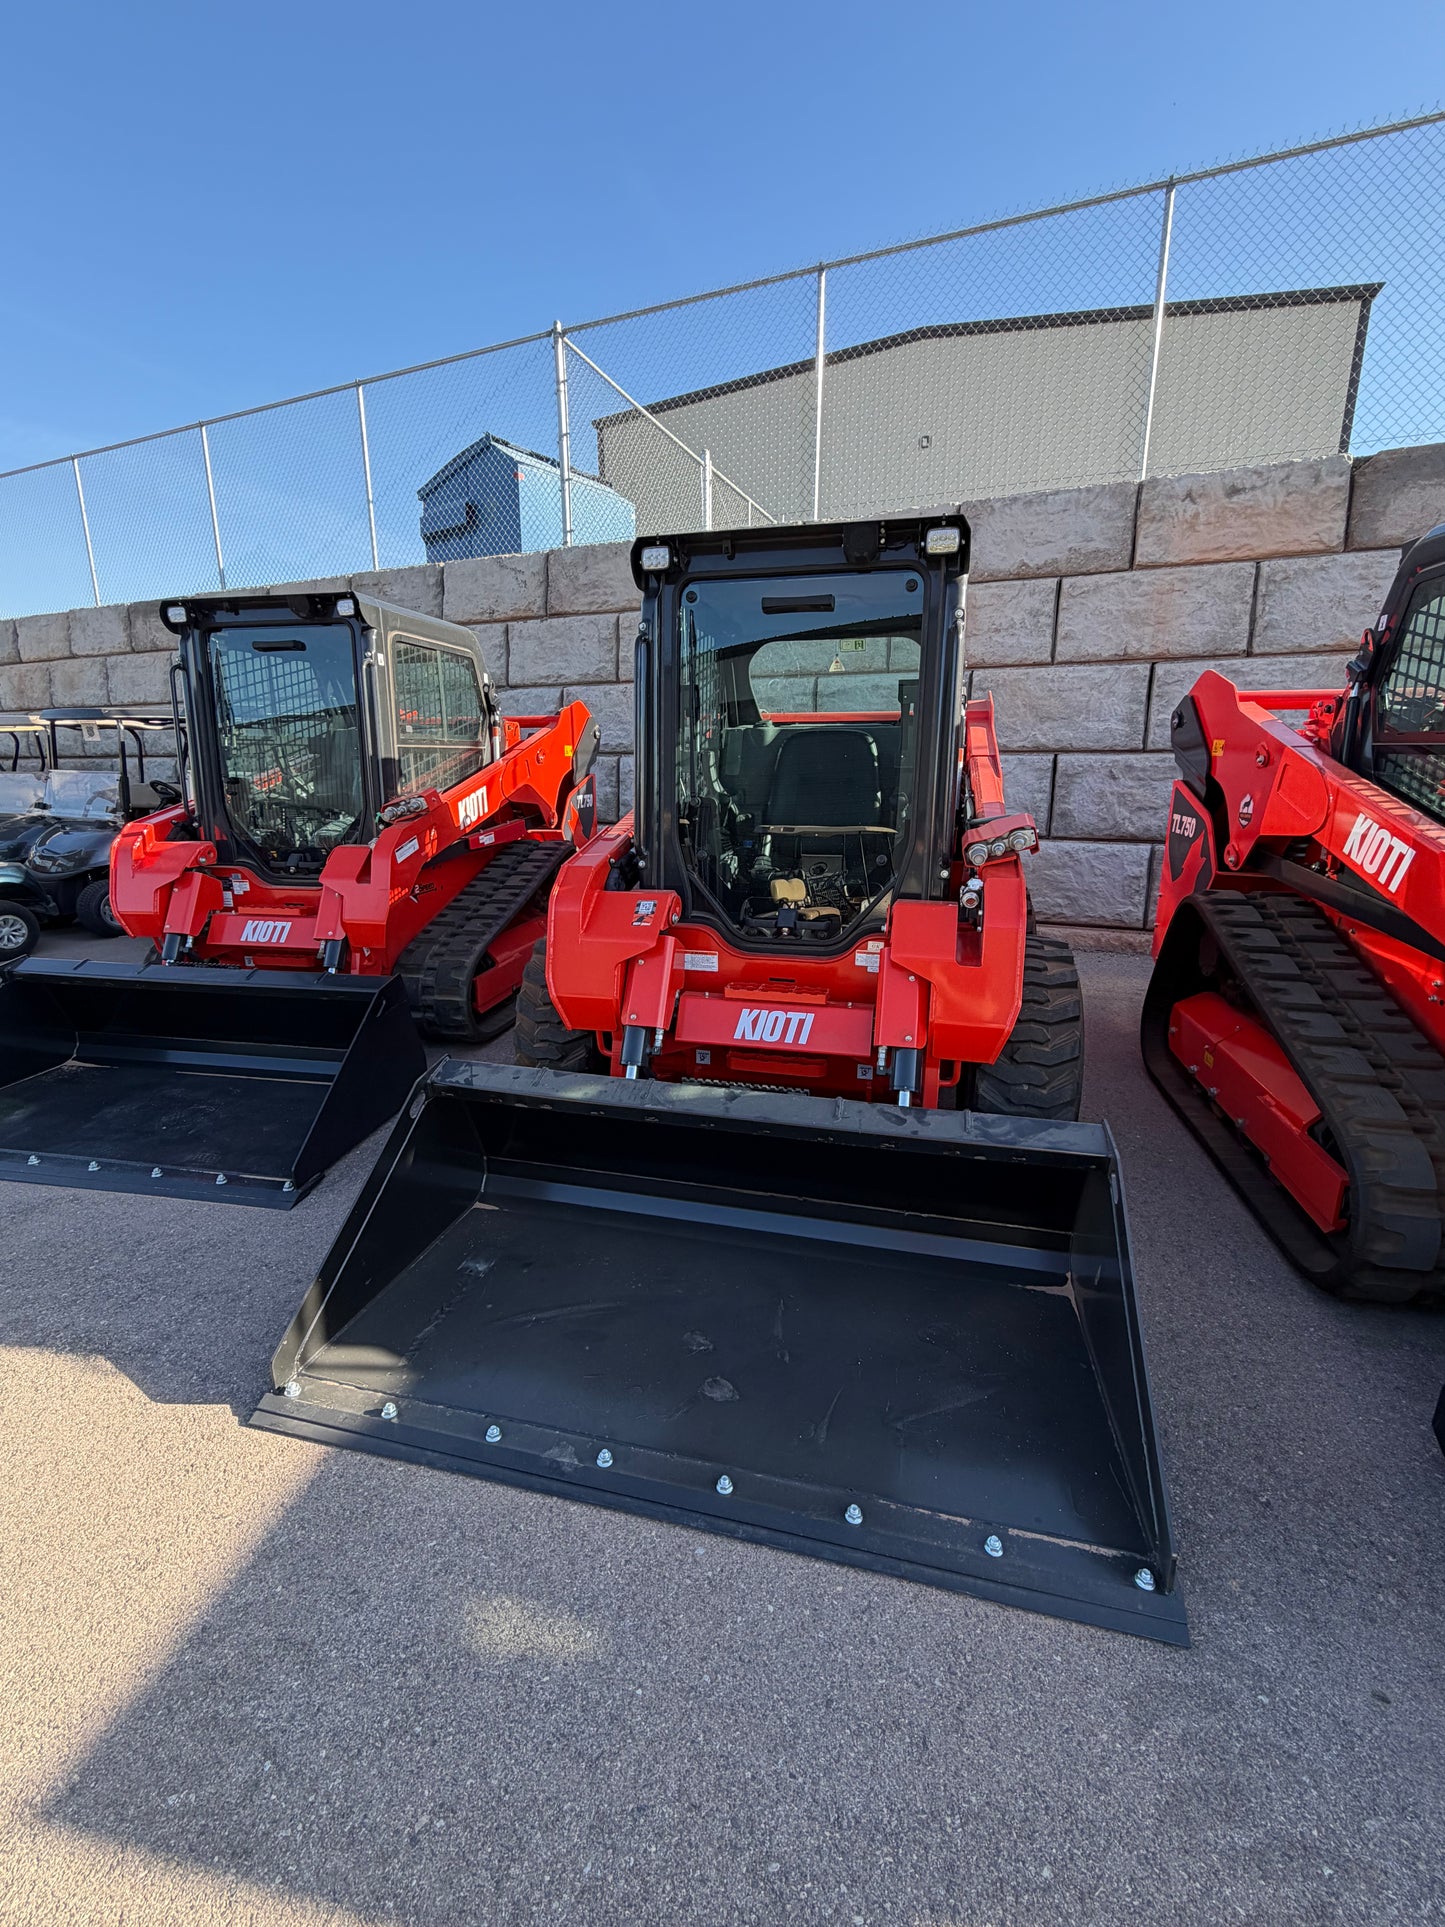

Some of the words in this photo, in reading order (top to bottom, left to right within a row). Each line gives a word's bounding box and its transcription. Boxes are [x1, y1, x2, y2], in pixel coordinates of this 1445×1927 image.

[458, 785, 489, 830] KIOTI
[1171, 813, 1196, 838] TL750
[1342, 812, 1416, 894] KIOTI
[240, 920, 292, 943] KIOTI
[733, 1008, 815, 1045] KIOTI
